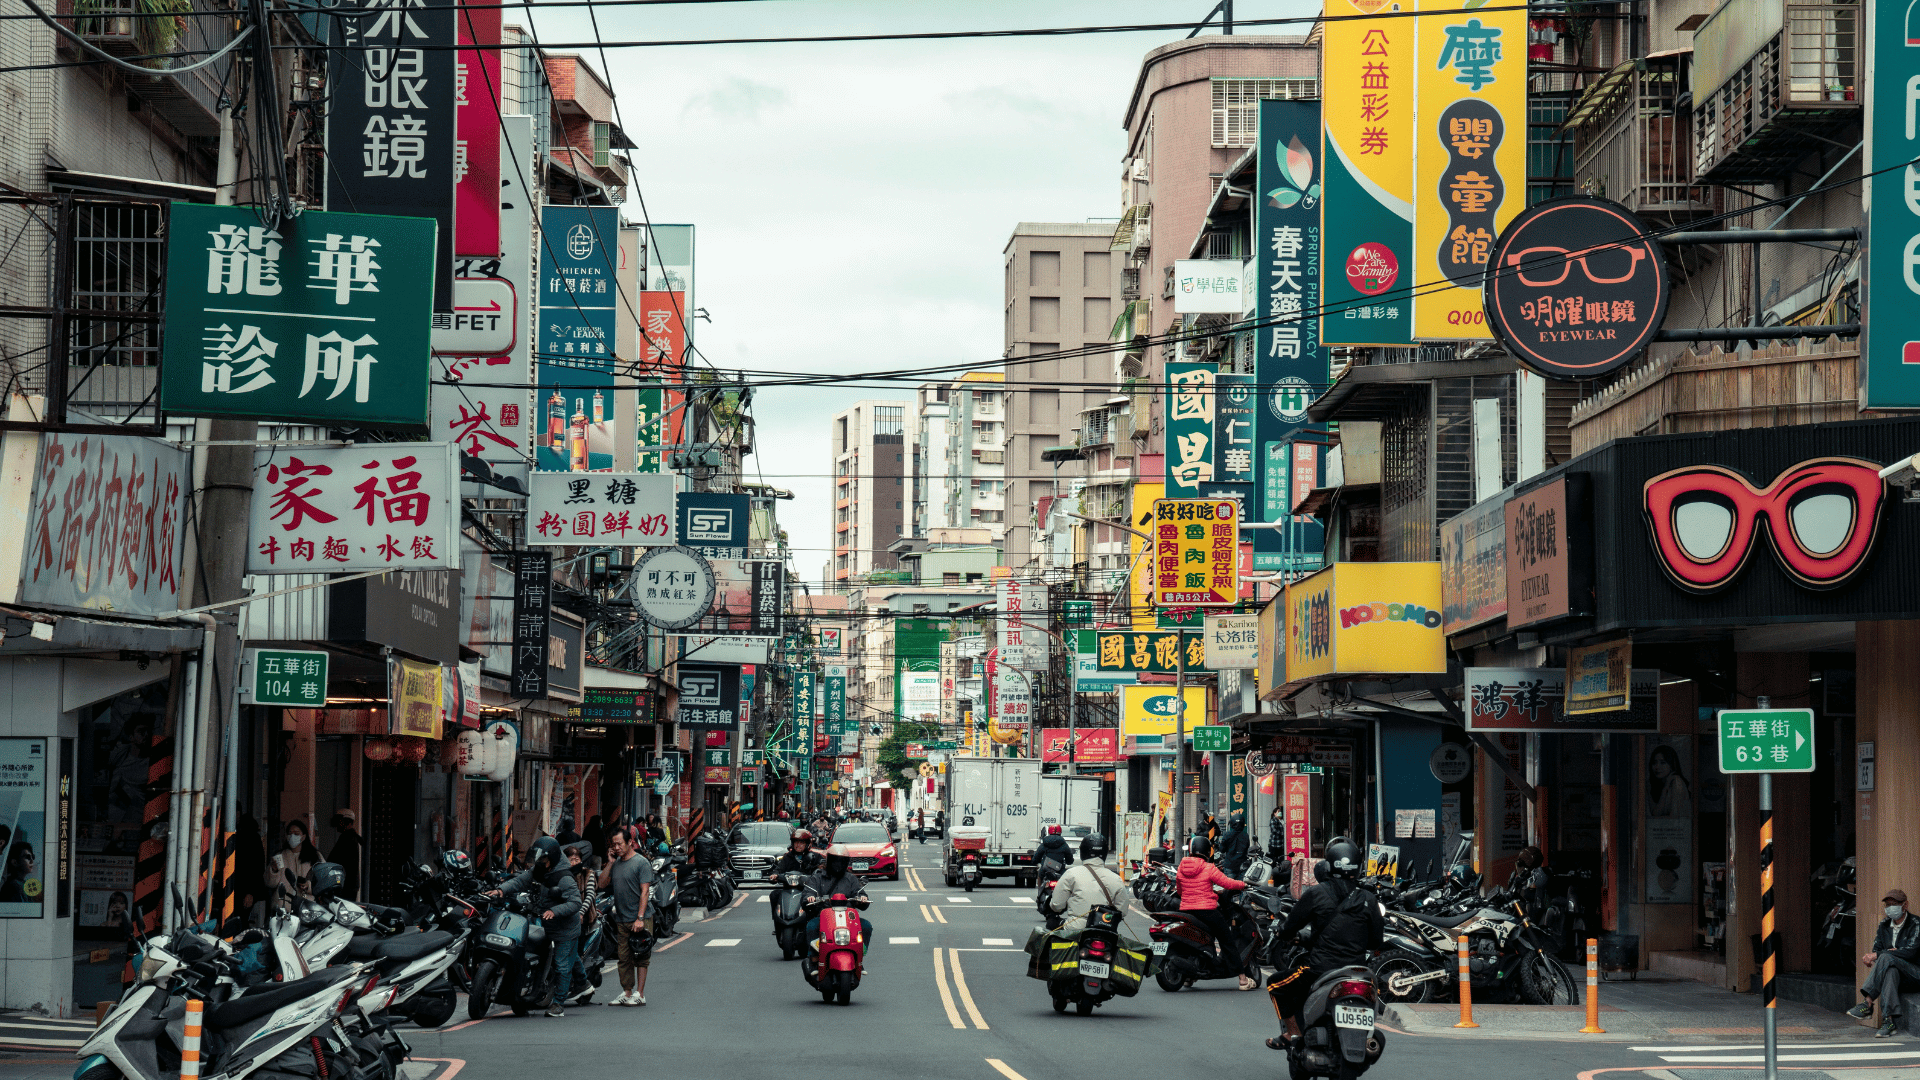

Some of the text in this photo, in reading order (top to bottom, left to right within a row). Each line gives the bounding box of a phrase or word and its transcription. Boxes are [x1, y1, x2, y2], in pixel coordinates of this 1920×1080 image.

[1360, 29, 1389, 156] 公益彩券
[1450, 117, 1494, 265] 嬰童館
[207, 223, 382, 305] 龍華
[1362, 249, 1381, 262] We
[1370, 258, 1386, 268] are
[1346, 263, 1399, 284] Family
[1269, 225, 1303, 359] 春天藥局
[1306, 226, 1318, 359] SPRING PHARMACY
[1344, 307, 1399, 320] 台灣彩券
[1520, 296, 1636, 328] 明曜眼鏡
[573, 331, 606, 339] LEADER
[1539, 329, 1617, 343] EYEWEAR
[201, 323, 379, 403] 診所
[1170, 369, 1213, 490] 國昌
[266, 455, 431, 531] 家福
[563, 478, 641, 505] 黑糖
[1157, 503, 1215, 521] 好好吃
[535, 511, 669, 539] 粉圓鮮奶
[691, 514, 728, 532] SF
[1158, 524, 1180, 589] 魯肉便當
[1185, 524, 1206, 589] 魯肉飯
[1211, 524, 1233, 589] 脆皮蚵仔煎
[647, 569, 697, 586] 可不可
[1521, 573, 1550, 602] EYEWEAR
[646, 587, 697, 601] 熟成紅茶
[1165, 593, 1212, 602] 巷內5公尺
[519, 556, 547, 694] 詳情請內洽
[1338, 601, 1442, 630] KODOMO
[263, 657, 320, 676] 五華街
[265, 680, 319, 699] 104 巷
[681, 677, 716, 695] SF
[1474, 680, 1547, 722] 鴻祥
[583, 708, 604, 716] 13:30
[610, 709, 632, 717] 22:30
[1196, 729, 1222, 738] 五華街
[1727, 719, 1790, 739] 五華街
[1006, 803, 1028, 816] 6295
[1336, 1012, 1374, 1027] LU9-589
